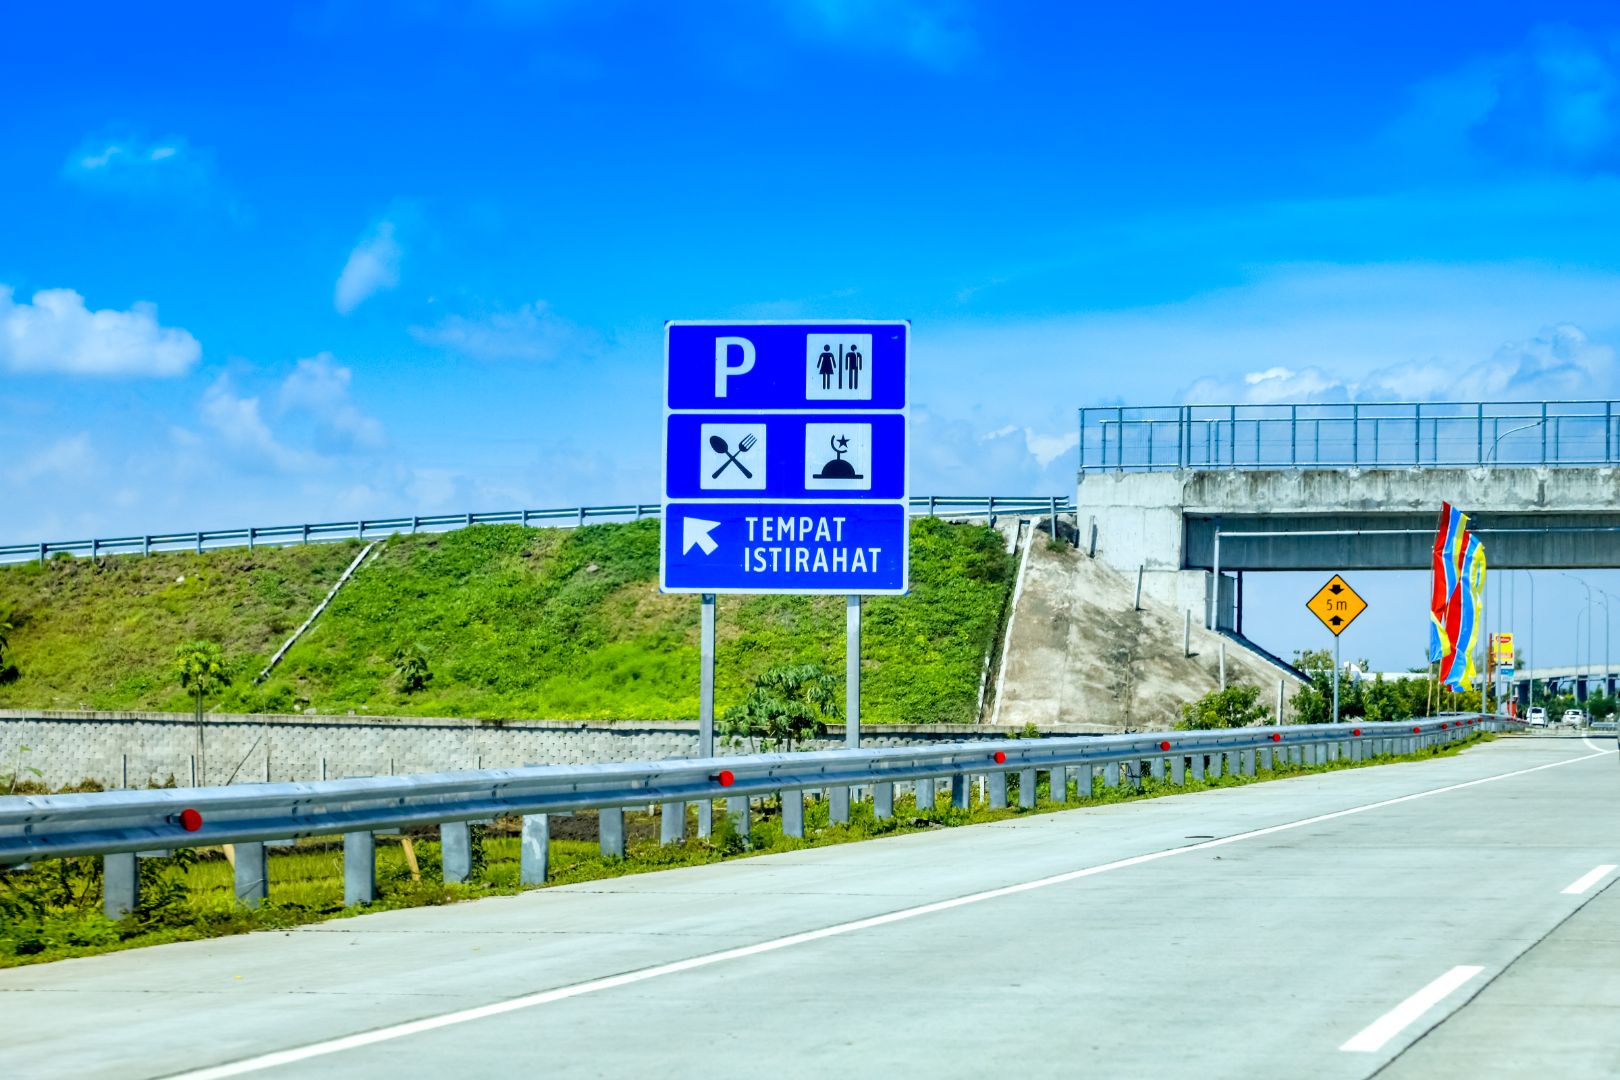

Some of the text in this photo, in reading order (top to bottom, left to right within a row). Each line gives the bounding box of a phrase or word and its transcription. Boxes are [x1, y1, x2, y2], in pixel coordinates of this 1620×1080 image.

[715, 336, 756, 398] P
[745, 516, 846, 542] TEMPAT
[744, 547, 882, 573] ISTIRAHAT
[1326, 599, 1347, 611] 5 m
